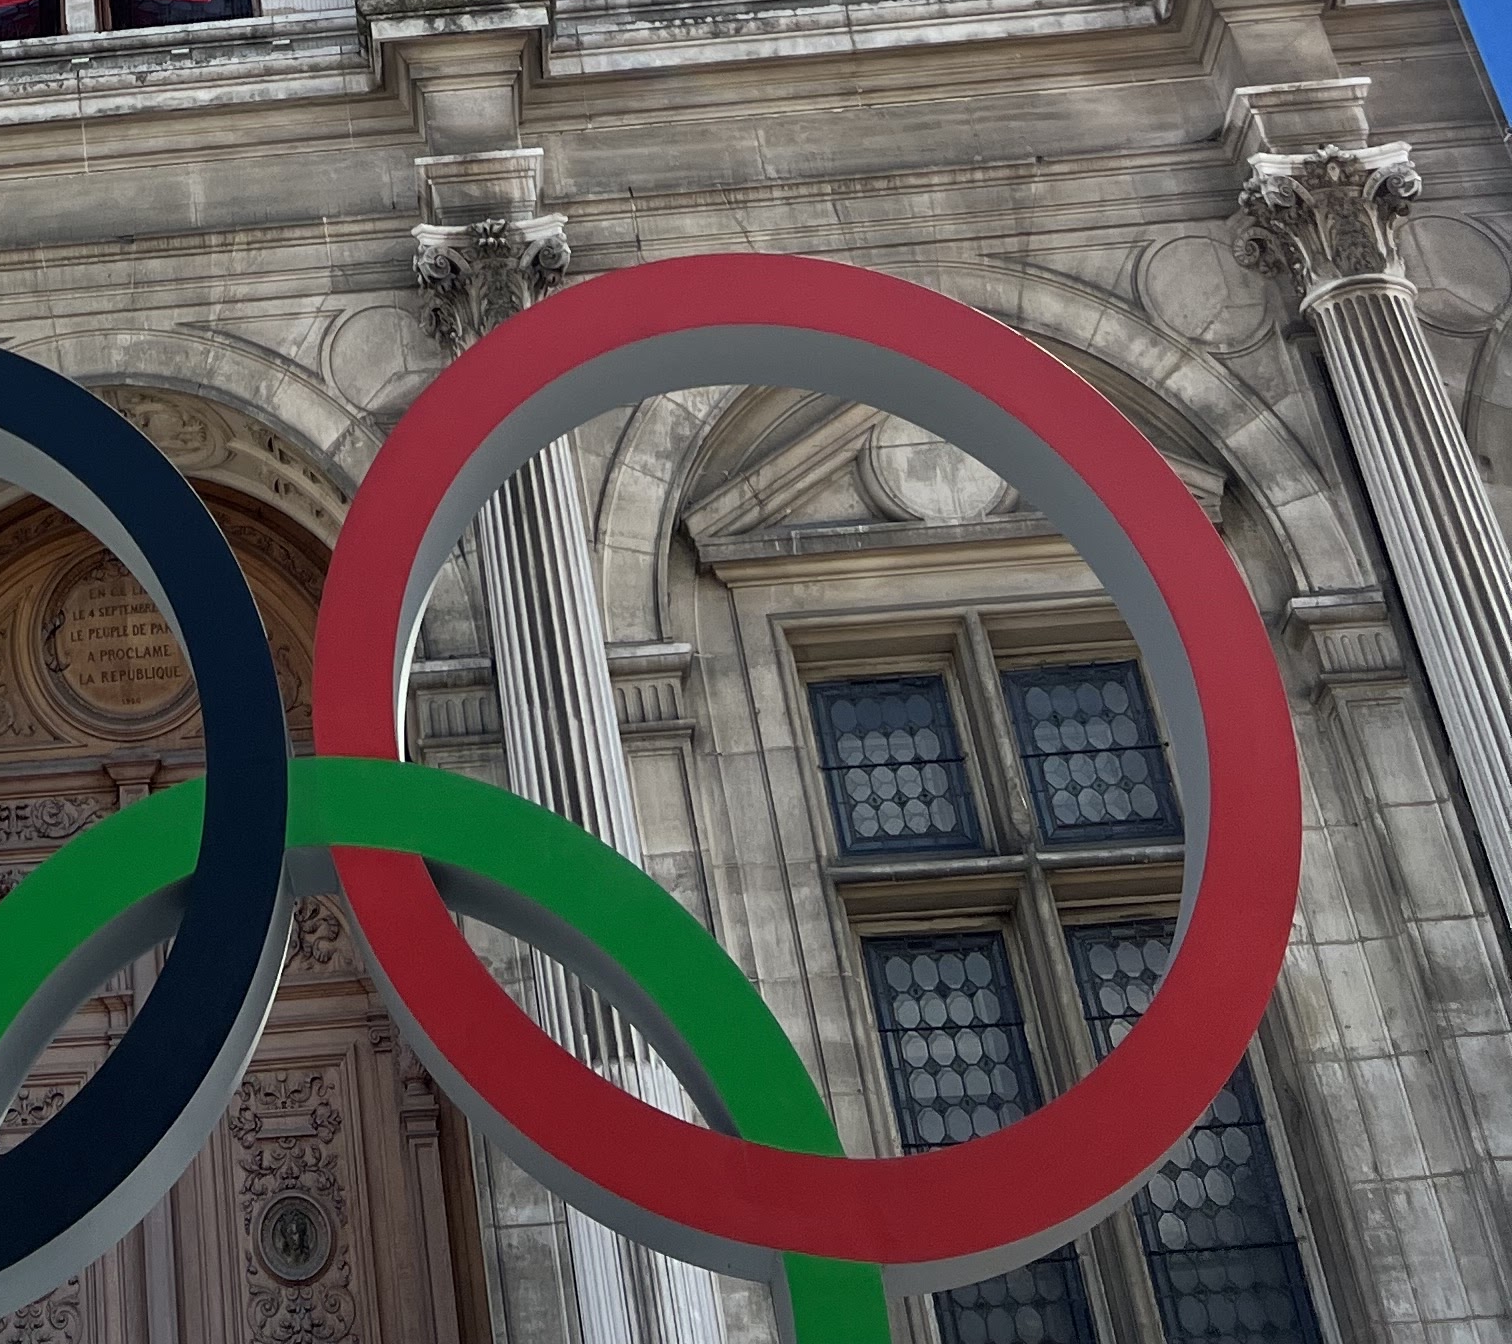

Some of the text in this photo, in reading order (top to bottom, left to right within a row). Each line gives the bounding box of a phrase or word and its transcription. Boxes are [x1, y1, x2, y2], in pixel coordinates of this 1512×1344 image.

[89, 588, 106, 600] EN
[73, 610, 85, 621] LE
[88, 608, 95, 618] 4
[70, 630, 83, 642] LE
[88, 624, 129, 640] PEUPLE
[132, 623, 147, 636] DE
[88, 652, 96, 663] A
[79, 673, 95, 685] LA
